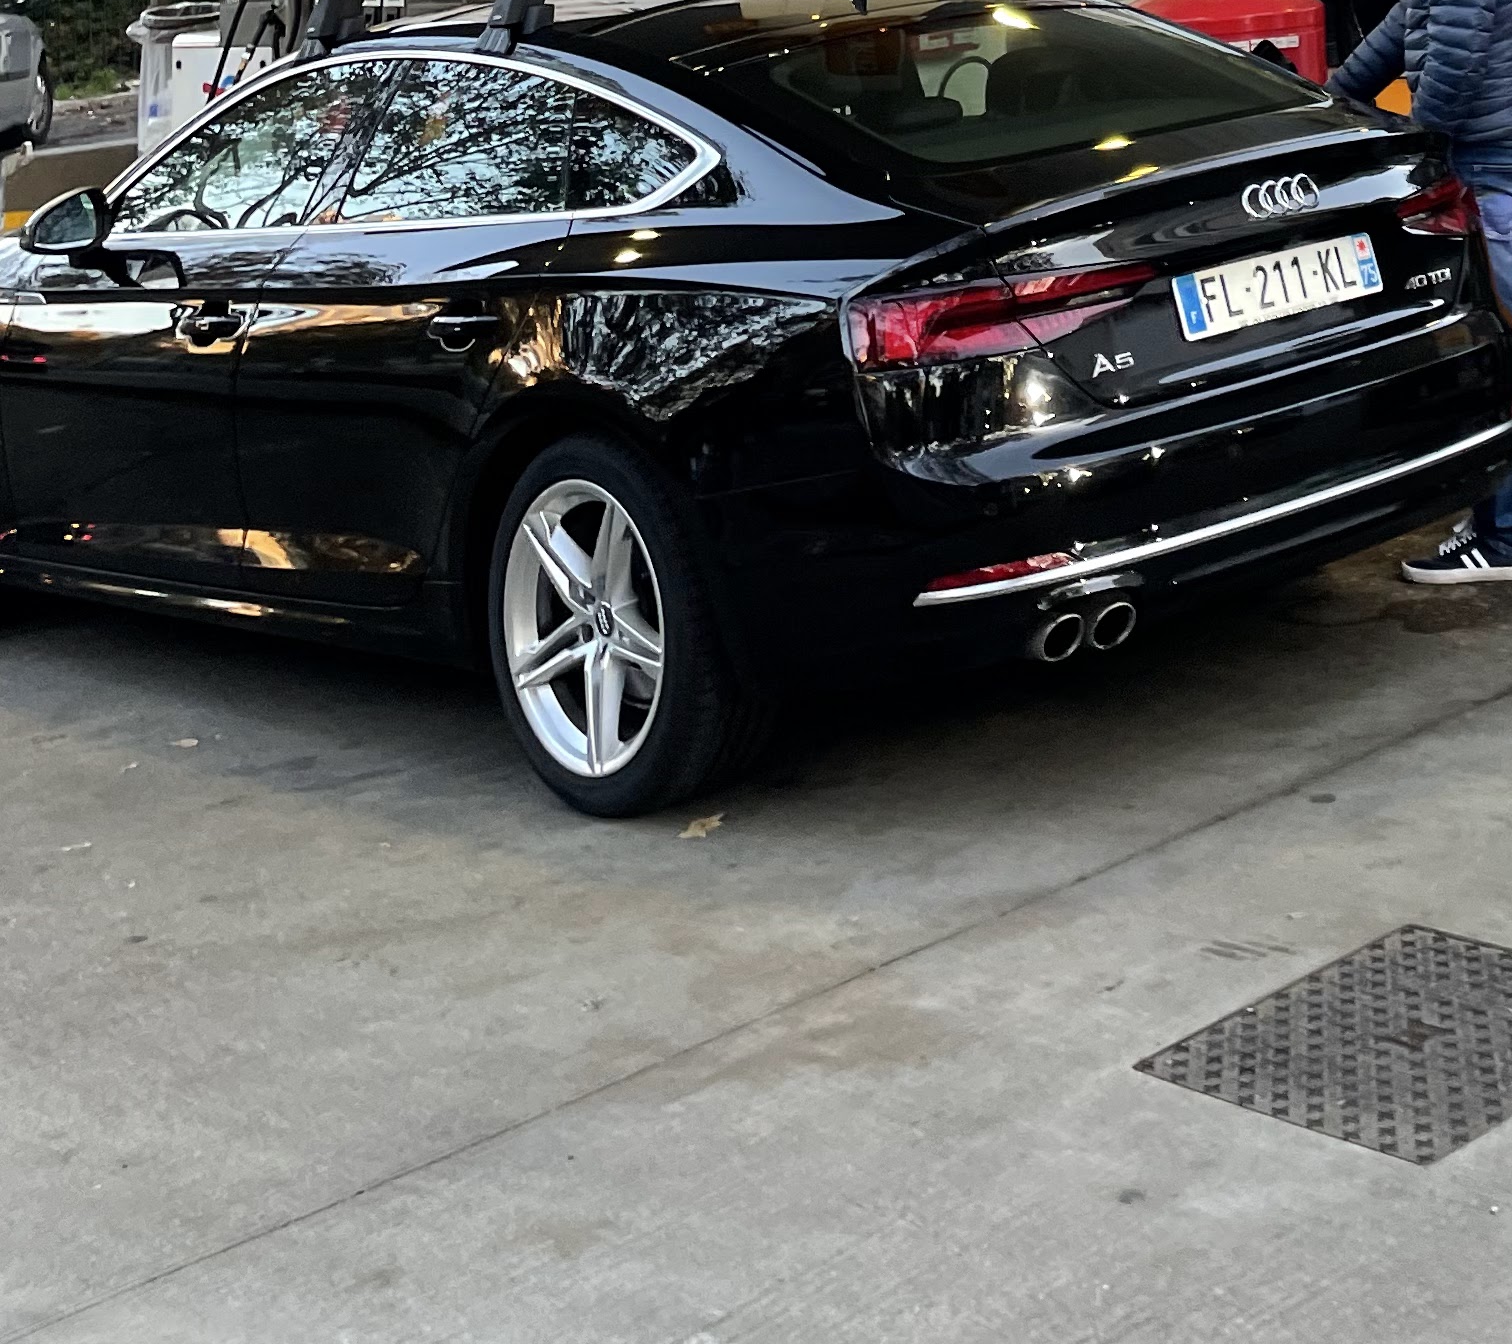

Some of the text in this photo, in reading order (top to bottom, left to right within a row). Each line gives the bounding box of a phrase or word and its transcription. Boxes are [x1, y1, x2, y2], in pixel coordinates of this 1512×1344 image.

[1361, 263, 1378, 286] 75
[1190, 311, 1198, 325] F
[1091, 350, 1135, 379] A5
